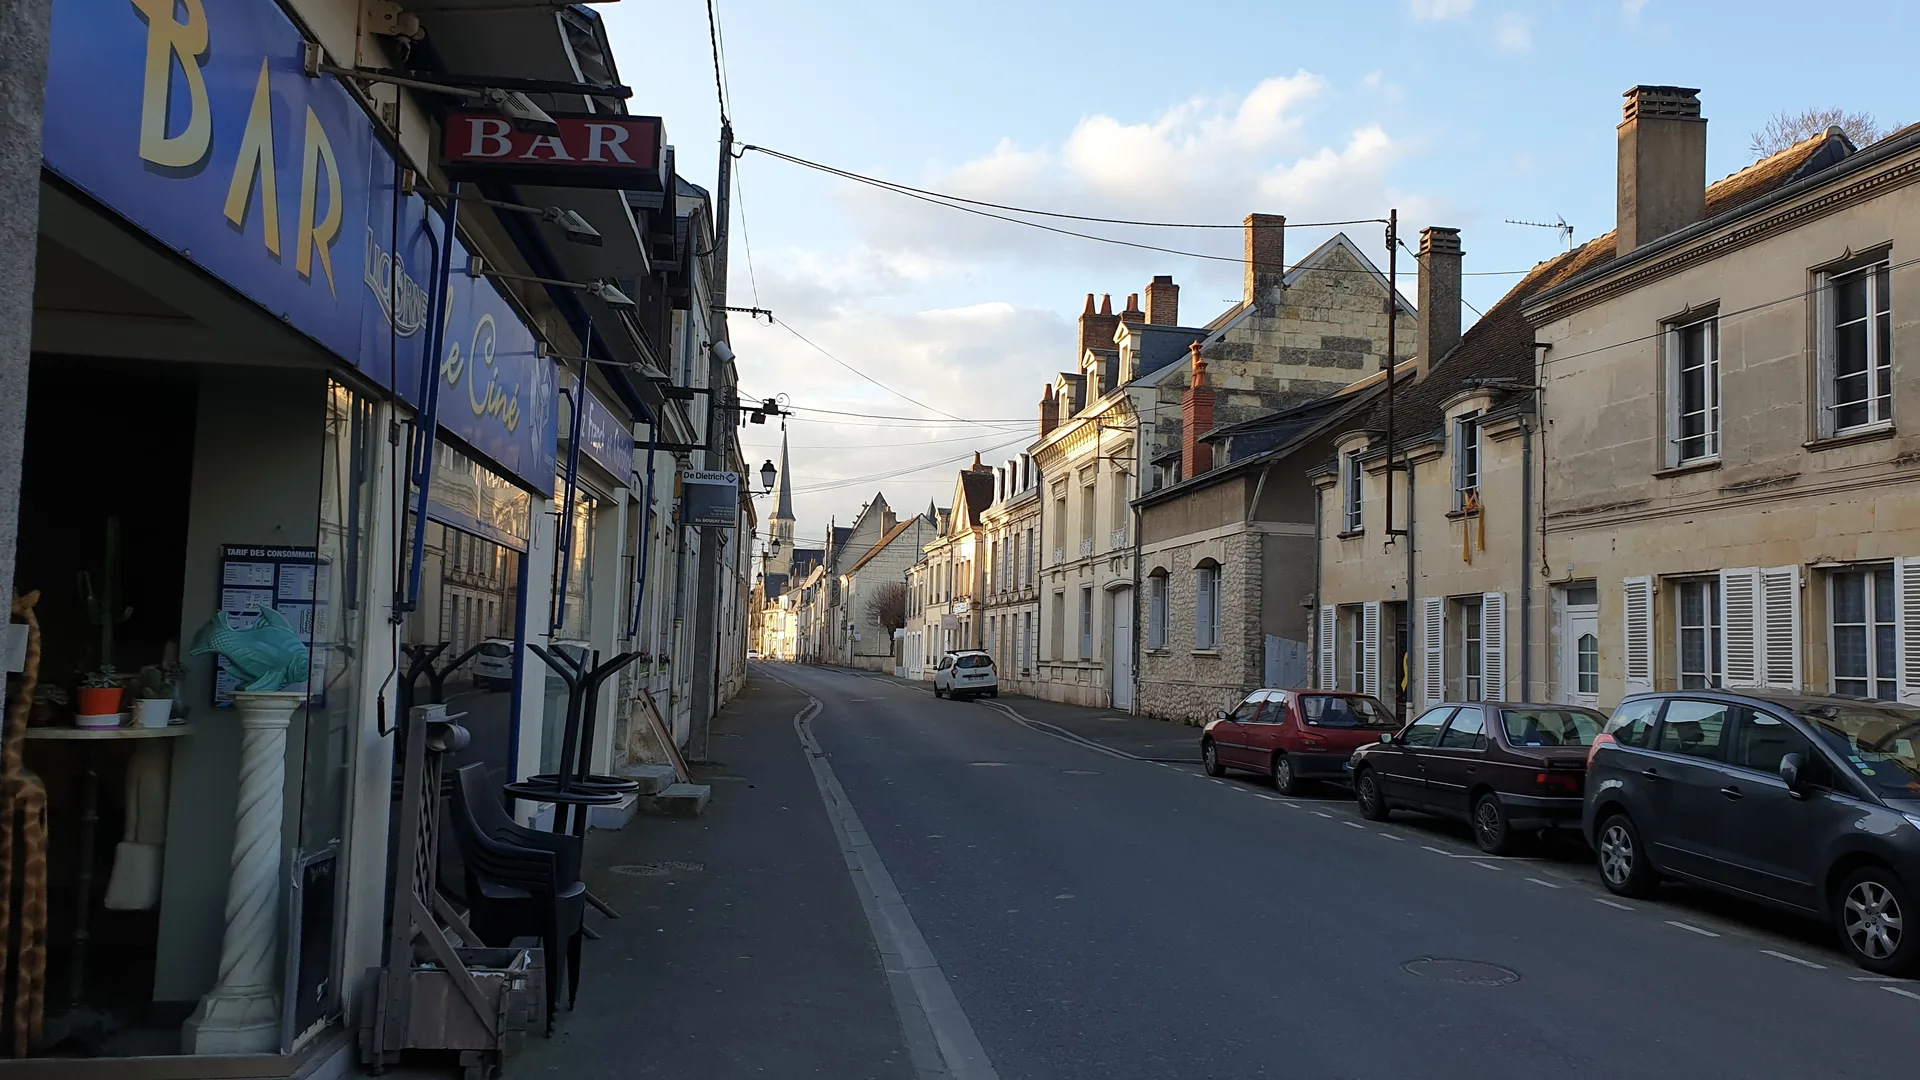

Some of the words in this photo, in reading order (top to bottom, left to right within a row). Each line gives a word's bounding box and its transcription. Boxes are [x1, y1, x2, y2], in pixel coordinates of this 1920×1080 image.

[131, 0, 342, 299] BAR
[462, 118, 637, 163] BAR
[469, 313, 520, 432] Ciné
[684, 471, 695, 479] De
[696, 472, 725, 481] Dietrich
[227, 548, 248, 556] TARIF
[250, 549, 265, 557] DES
